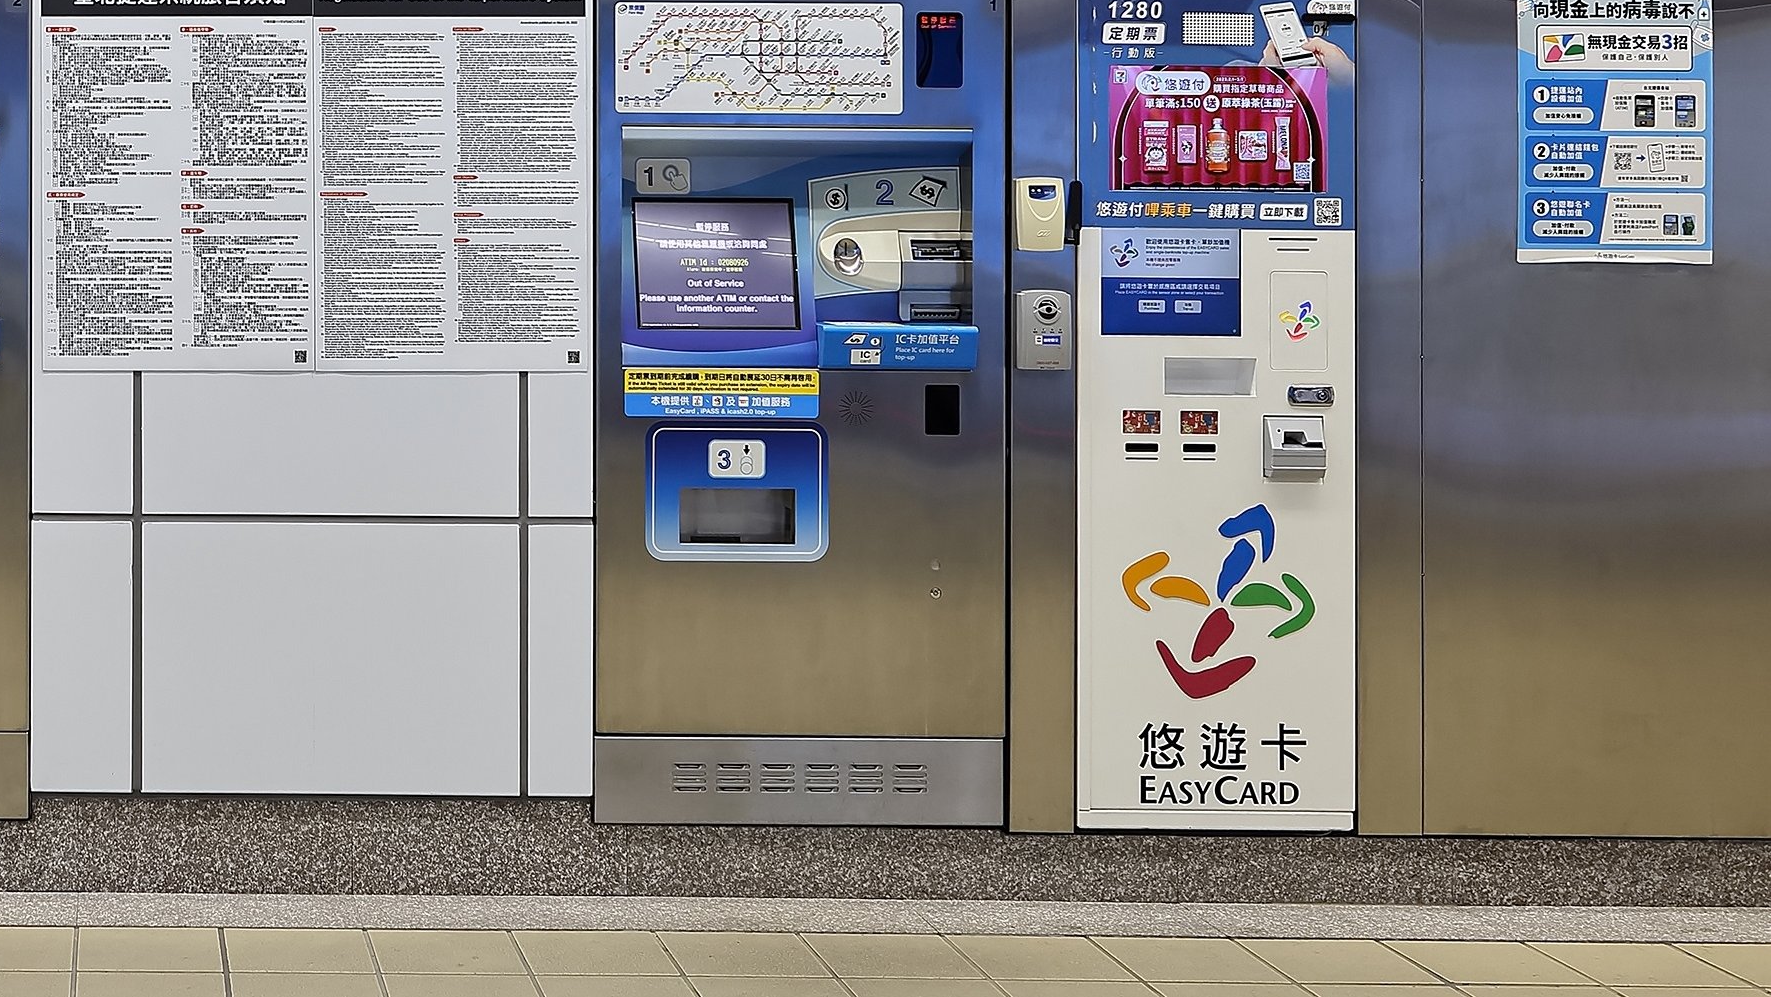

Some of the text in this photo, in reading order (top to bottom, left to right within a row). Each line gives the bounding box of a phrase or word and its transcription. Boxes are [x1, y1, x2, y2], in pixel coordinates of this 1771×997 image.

[989, 0, 997, 11] 1
[1108, 1, 1162, 19] 1280
[1533, 0, 1694, 20] 向現金上的病毒說不
[1108, 27, 1158, 40] 定期票
[1587, 34, 1688, 50] 無現金交易3招
[1165, 78, 1205, 91] 悠遊付
[1538, 89, 1545, 101] 1
[1537, 146, 1545, 157] 2
[643, 166, 654, 187] 1
[875, 179, 894, 205] 2
[1263, 207, 1304, 218] 立即下載
[1537, 202, 1545, 215] 3
[714, 280, 744, 288] Service
[640, 294, 665, 302] Please
[895, 334, 959, 344] IC卡加值平台
[651, 396, 790, 407] 本機提供 及 加值服務
[665, 408, 695, 416] EasyCard
[754, 408, 776, 416] top-up
[716, 449, 732, 471] 3
[1138, 722, 1307, 771] 悠遊卡
